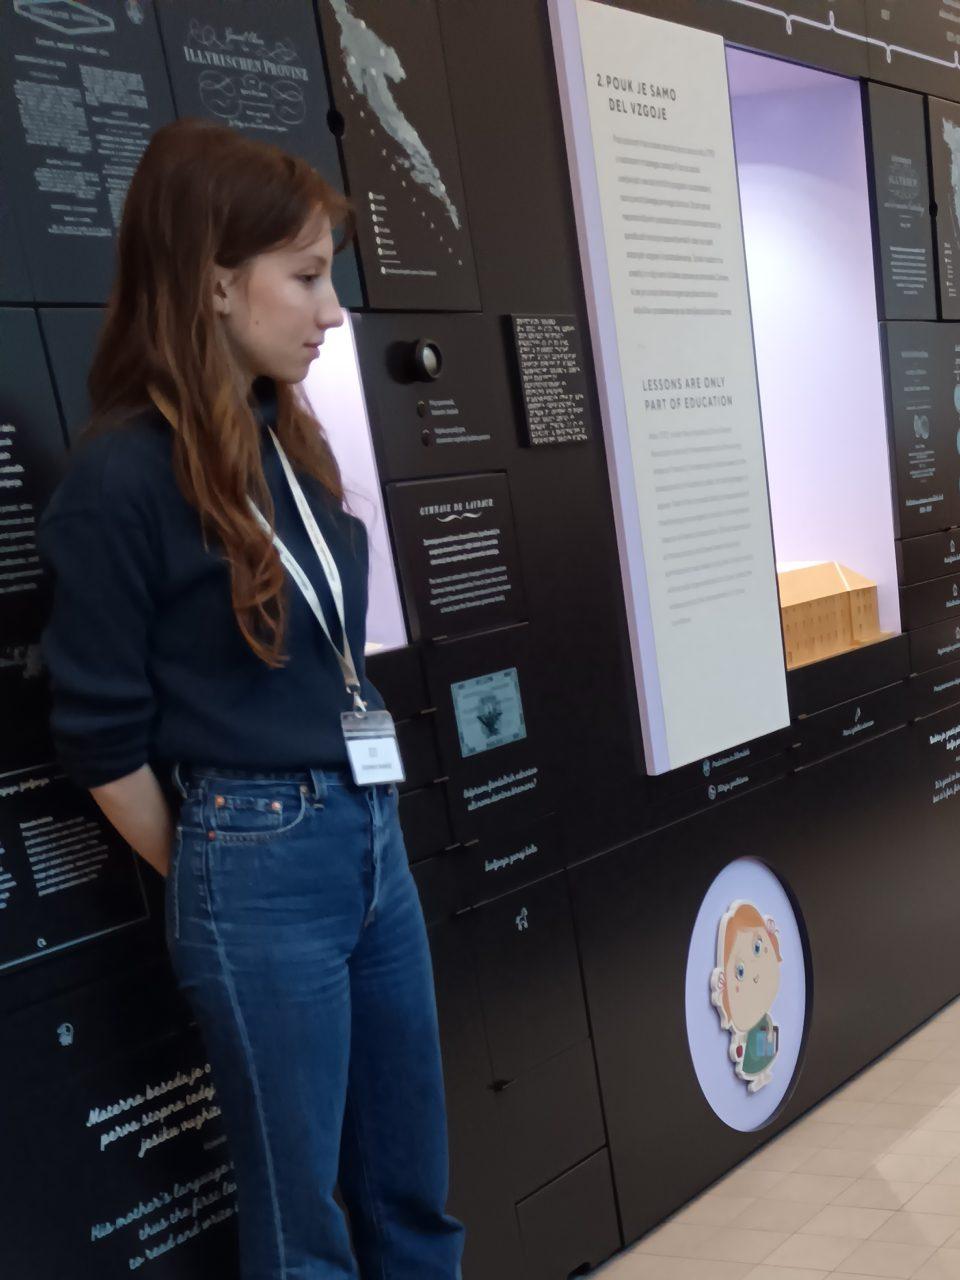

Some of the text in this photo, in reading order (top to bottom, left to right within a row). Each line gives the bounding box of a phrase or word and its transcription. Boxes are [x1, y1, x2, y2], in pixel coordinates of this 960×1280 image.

[605, 74, 634, 93] POUK
[636, 82, 647, 96] JE
[649, 84, 677, 102] SAMO
[608, 98, 667, 121] DEL VZGOJE
[641, 376, 726, 393] LESSONS ARE ONLY
[645, 395, 733, 411] PART OF EDUCATION
